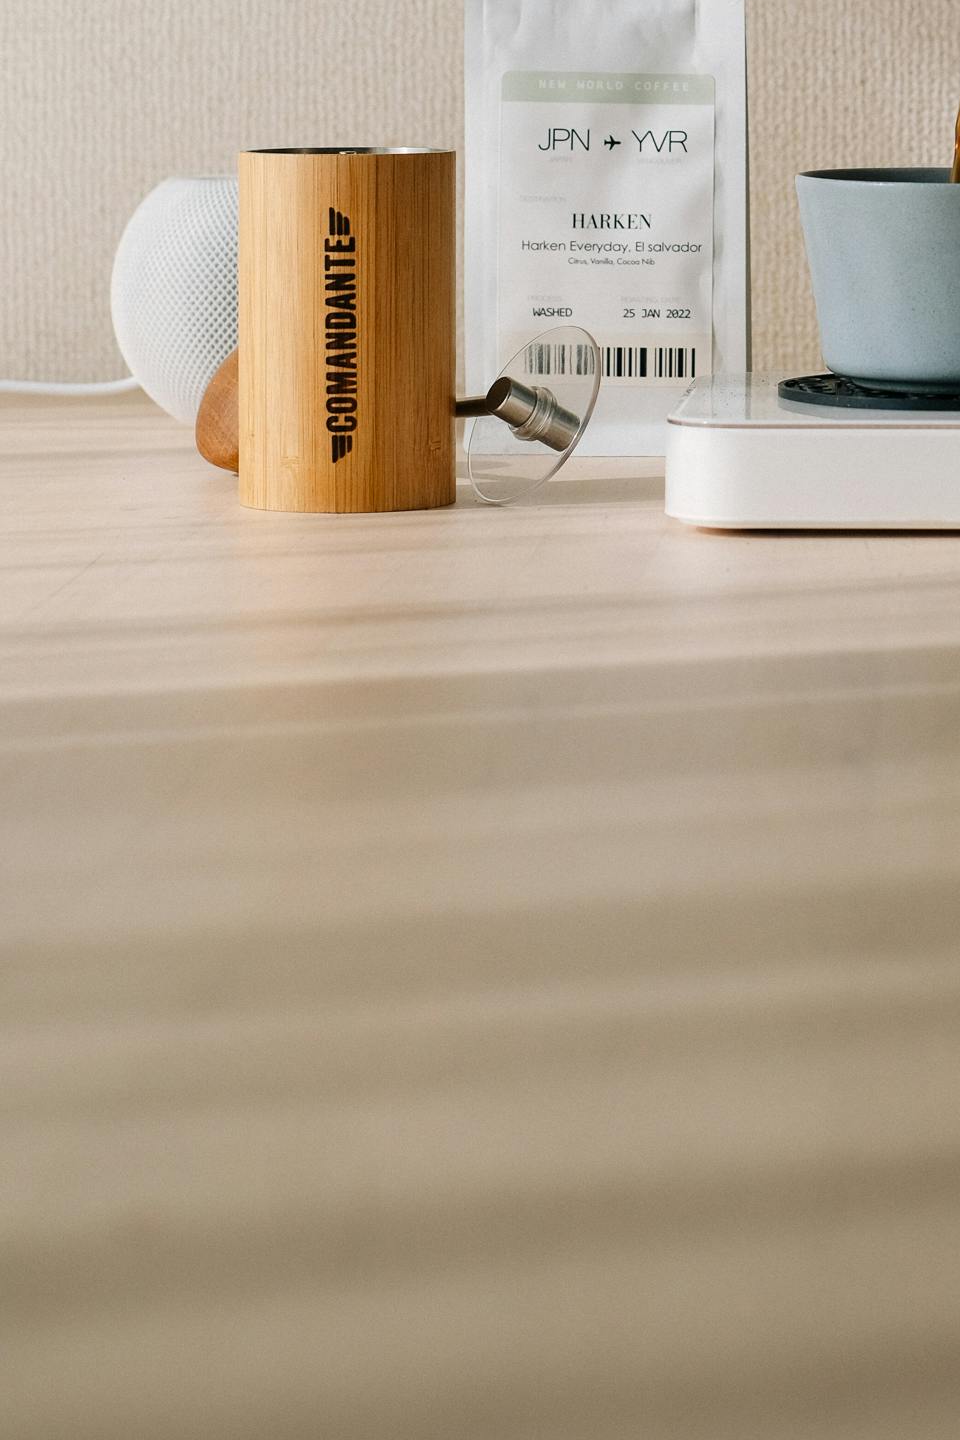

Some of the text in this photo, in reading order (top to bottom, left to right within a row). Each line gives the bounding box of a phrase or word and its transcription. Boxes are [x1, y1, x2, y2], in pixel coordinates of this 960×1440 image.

[538, 79, 690, 92] NEW WORLD COFFEE
[538, 128, 688, 153] JPN YVR
[571, 213, 652, 230] HARKEN
[521, 240, 566, 252] Harken
[635, 242, 645, 252] El
[648, 242, 702, 253] salvador
[616, 258, 640, 266] Cocoa
[641, 258, 655, 266] Nib
[532, 308, 573, 317] WASHED
[623, 309, 692, 319] 25 JAN 2022
[324, 236, 358, 433] COMANDANTE
